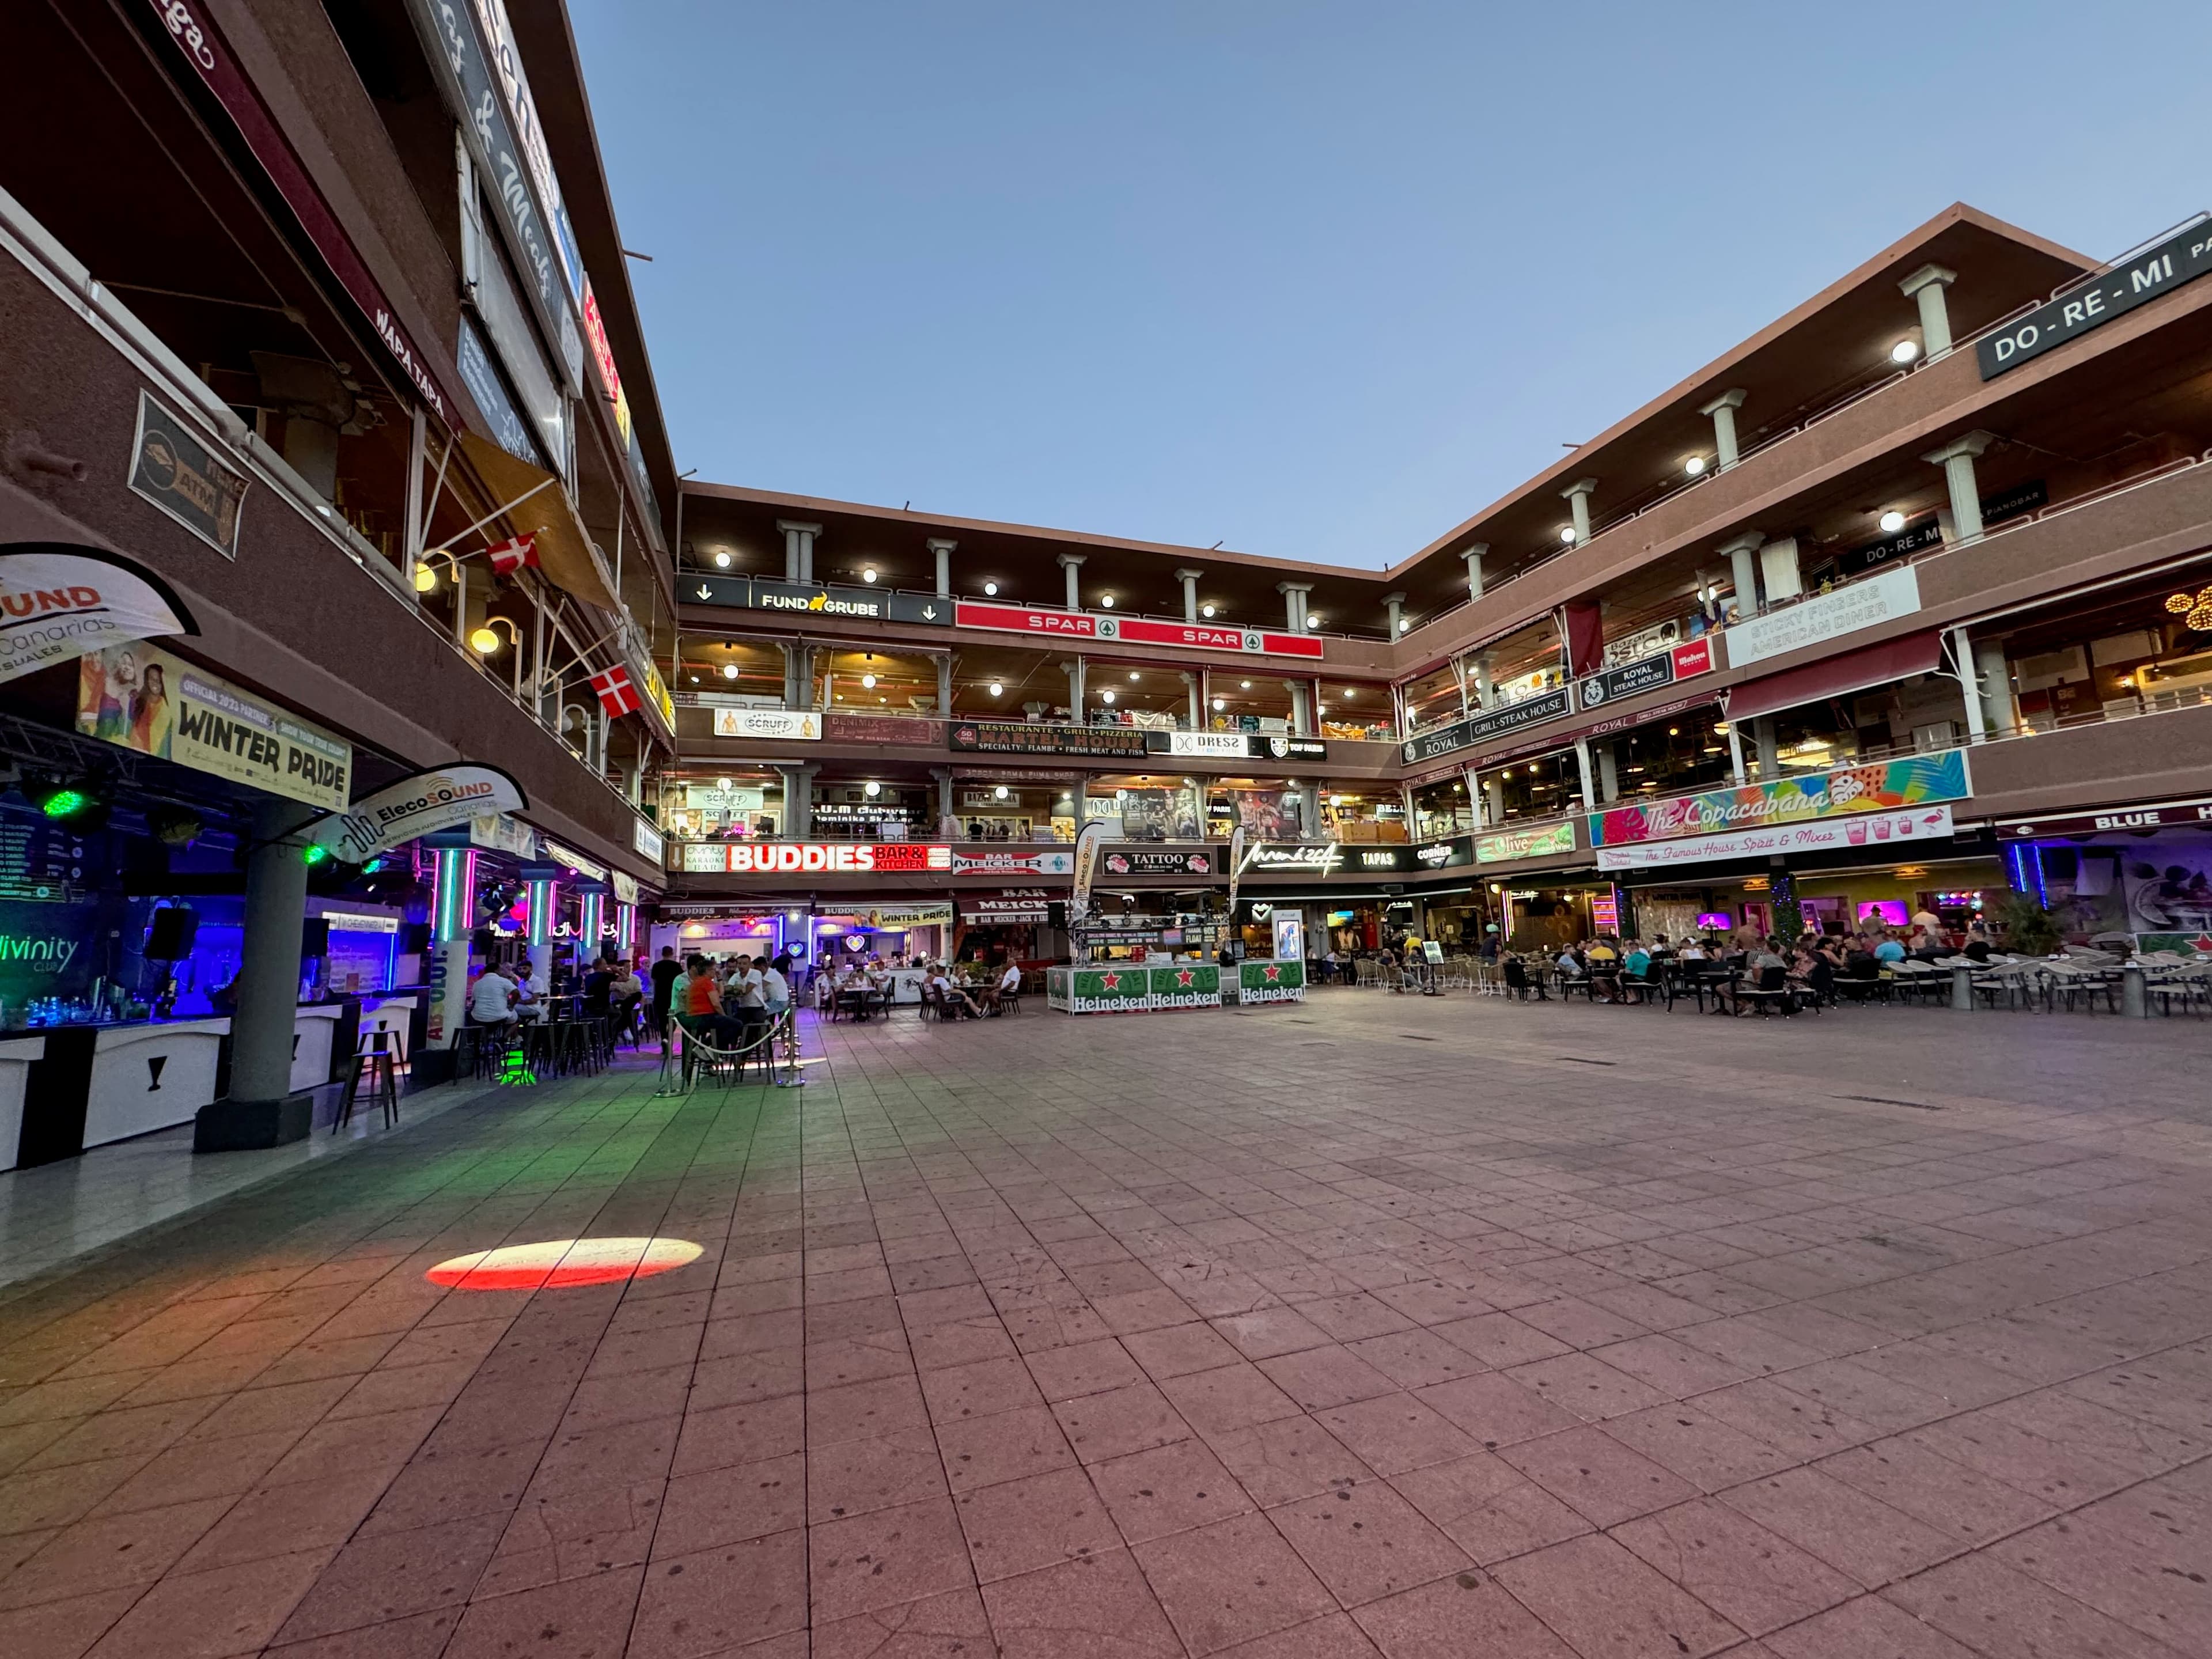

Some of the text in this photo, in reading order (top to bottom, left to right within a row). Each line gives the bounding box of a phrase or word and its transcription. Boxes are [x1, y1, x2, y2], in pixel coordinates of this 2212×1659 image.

[161, 0, 215, 70] ga
[499, 150, 552, 298] Meals
[1994, 325, 2039, 362] DO
[2062, 289, 2105, 328] RE
[2131, 254, 2173, 293] MI
[377, 309, 445, 418] WAPA TAPA
[1986, 491, 2041, 518] PIANOBAR
[1866, 545, 1886, 563] DO
[1897, 535, 1915, 552] RE
[0, 586, 102, 620] UND
[762, 594, 880, 618] FUND GRUBE
[1751, 585, 1880, 640] STICKY FINGERS
[1028, 615, 1091, 633] SPAR
[1750, 601, 1887, 657] AMERICAN DINER
[1183, 630, 1238, 646] SPAR
[1611, 632, 1649, 652] Bazar
[0, 645, 63, 672] SUALES
[1623, 664, 1653, 680] ROYAL
[1613, 671, 1664, 694] STEAK HOUSE
[183, 680, 218, 703] OFFICIAL
[748, 718, 790, 729] SCRUFF
[831, 717, 879, 728] DENIMIX
[978, 724, 1144, 738] RESTAURANTE GRILL PIZZERIA
[1426, 698, 1562, 756] ROYAL GRILL-STEAK HOUSE
[1592, 718, 1629, 734] ROYAL
[178, 700, 281, 774] WINTER
[287, 746, 346, 793] PRIDE
[980, 731, 1143, 749] MARTEL HOUSE
[978, 742, 1024, 751] SPECIALTY:
[1028, 744, 1056, 752] FLAMBE
[1065, 746, 1089, 754] FRESH
[1091, 747, 1109, 755] MEAT
[1128, 748, 1145, 756] FISH
[1482, 751, 1508, 766] ROYAL
[1402, 776, 1423, 789] ROYAL
[376, 782, 493, 822] ElecoSOUND
[997, 793, 1017, 803] MA
[447, 800, 498, 815] Canarias
[704, 810, 747, 818] SCFF
[1647, 791, 1830, 832] The Copacabana
[2094, 811, 2161, 830] BLUE
[875, 847, 909, 859] BAR
[911, 847, 923, 859] &
[1417, 845, 1452, 860] CORNER
[1645, 849, 1659, 861] The
[1662, 847, 1702, 859] Famous
[1703, 842, 1737, 855] House
[1740, 838, 1775, 853] Spirit
[1779, 834, 1790, 846] &
[1795, 829, 1836, 844] Mixer
[730, 846, 874, 871] BUDDIES
[875, 859, 925, 870] KITCHEN
[953, 859, 1042, 868] MEICKER
[1132, 854, 1184, 864] TATTOO
[1361, 853, 1393, 866] TAPAS
[1002, 888, 1048, 897] BAR
[881, 912, 921, 923] WINTER
[923, 910, 952, 920] PRIDE
[980, 915, 991, 923] BAR
[994, 915, 1017, 923] MEICKER
[1018, 915, 1033, 923] JACK
[1185, 934, 1202, 944] FLOAT
[1152, 991, 1220, 1009] Heineken
[1241, 986, 1304, 1002] Heineken
[1074, 995, 1149, 1011] Heineken
